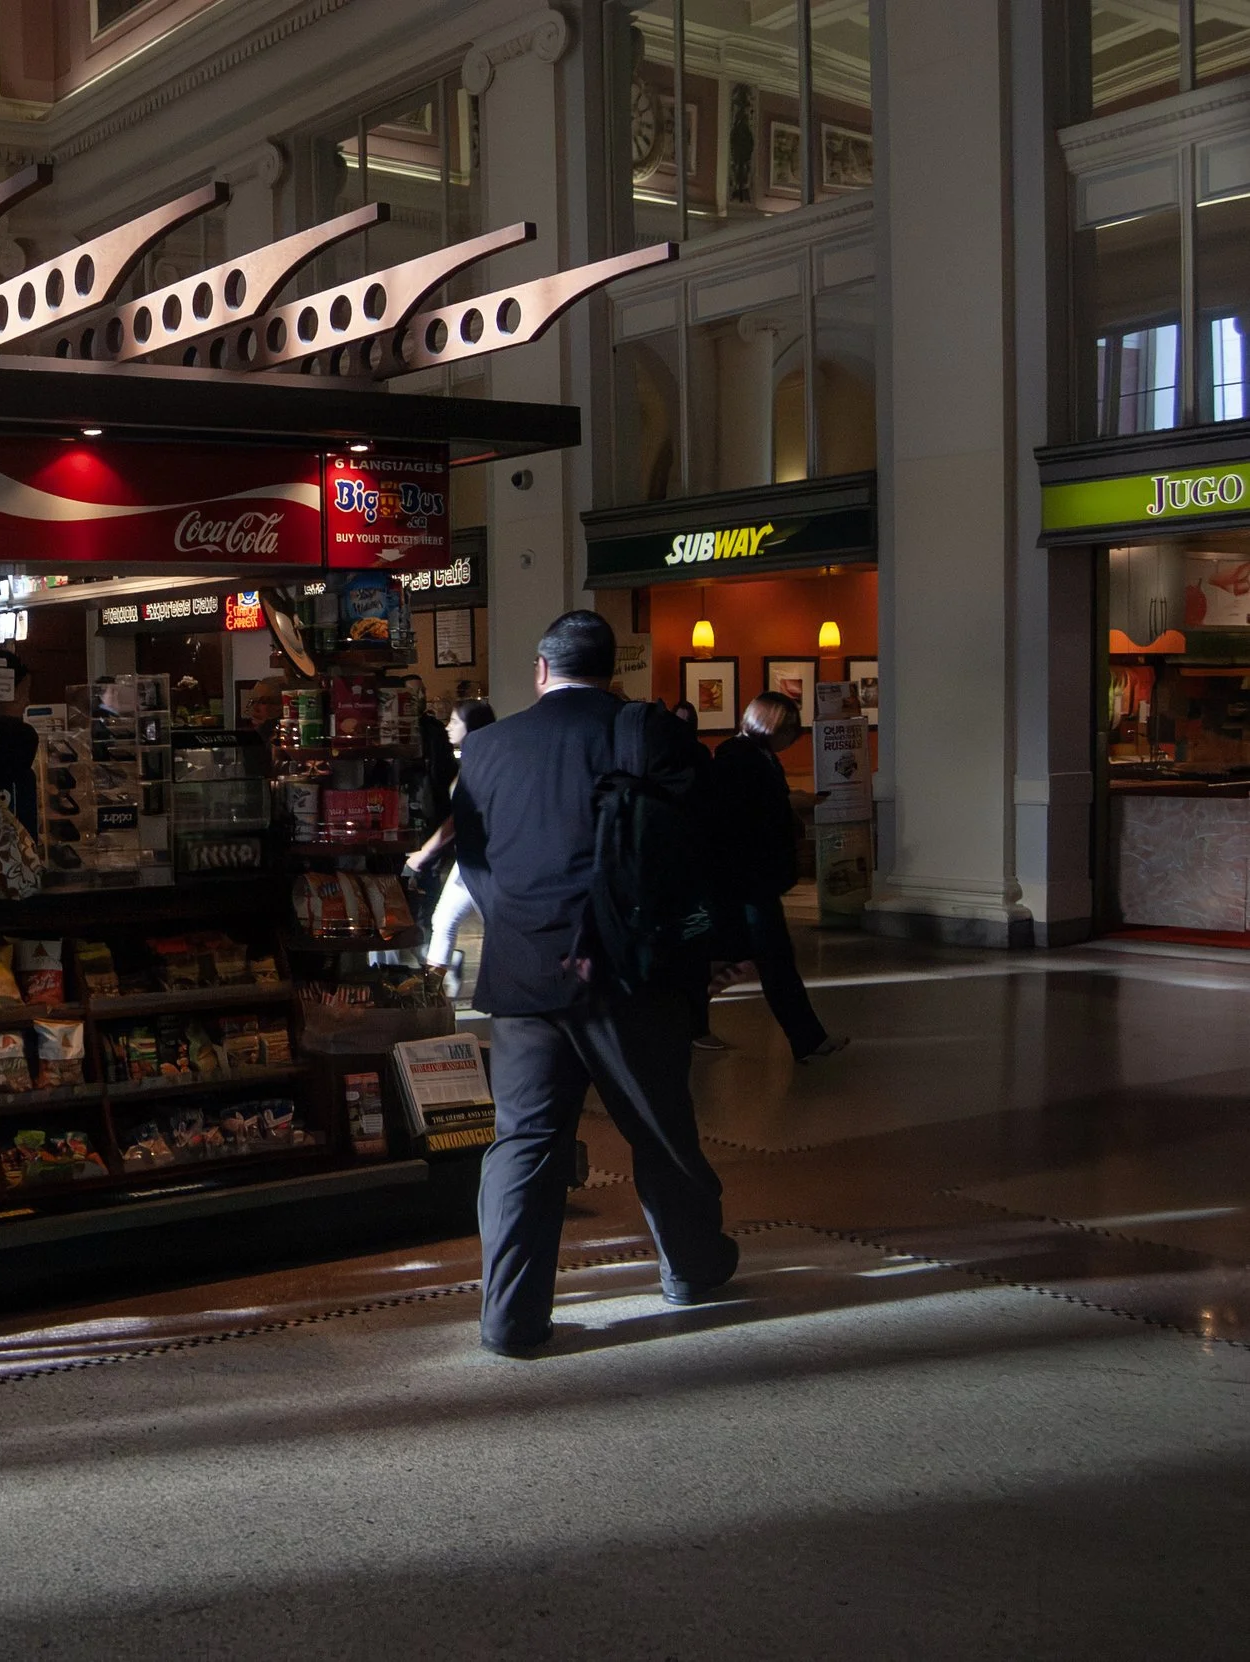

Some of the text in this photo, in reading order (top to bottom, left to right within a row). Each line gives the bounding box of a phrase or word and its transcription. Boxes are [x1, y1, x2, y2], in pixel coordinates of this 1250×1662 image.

[334, 458, 445, 474] 6 LANGUAGES
[334, 478, 444, 523] Big Bus
[1146, 473, 1245, 516] JUGO
[174, 510, 285, 555] Coca-Cola
[335, 532, 444, 546] BUY YOUR TICKETS HERE
[664, 522, 774, 566] SUBWAY
[433, 557, 471, 588] Café
[102, 605, 138, 625] Station
